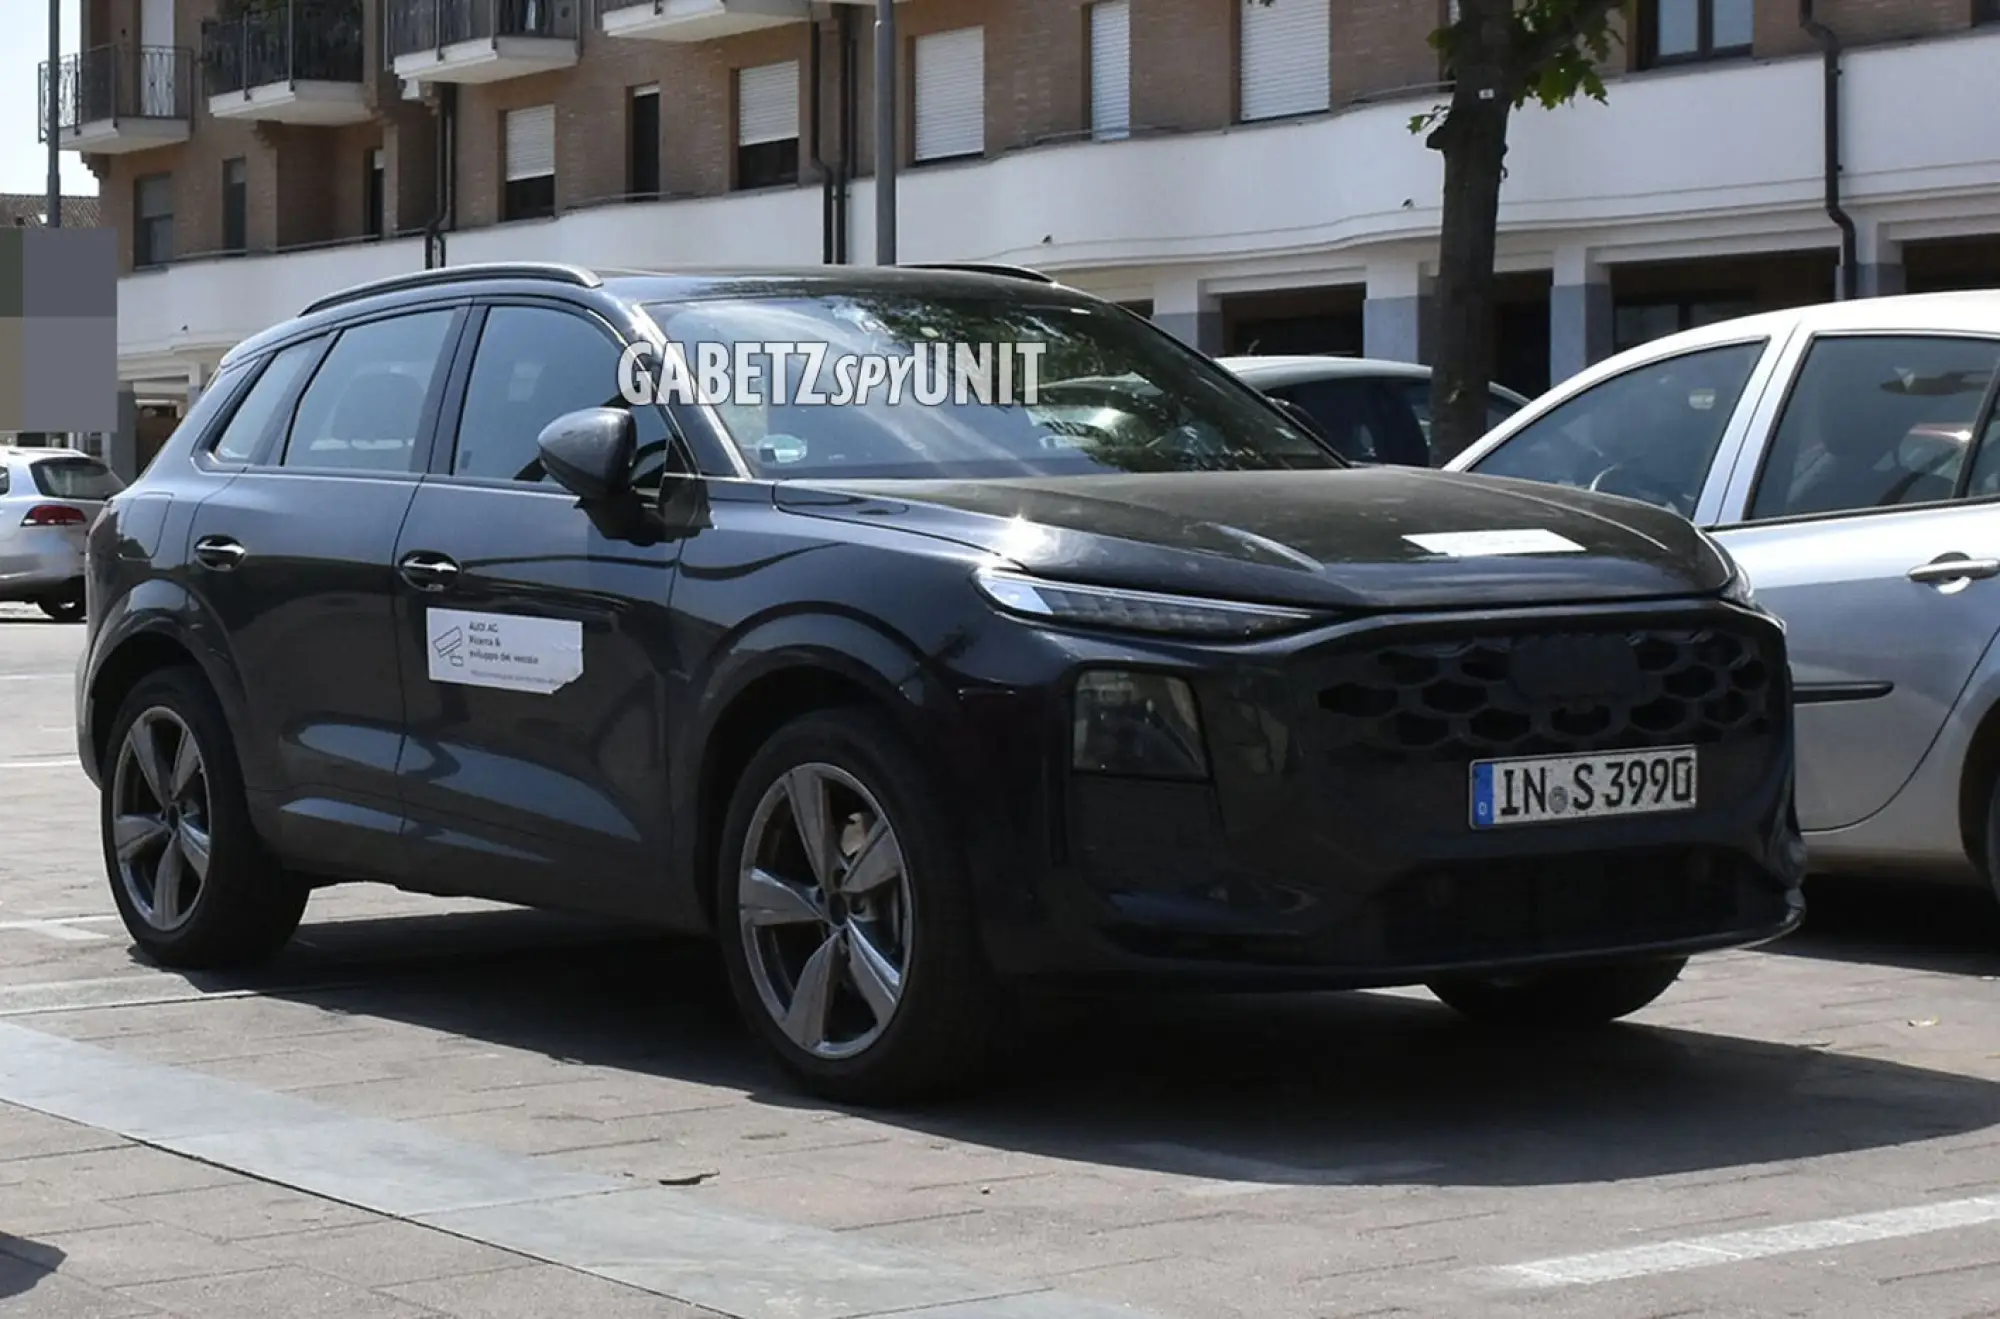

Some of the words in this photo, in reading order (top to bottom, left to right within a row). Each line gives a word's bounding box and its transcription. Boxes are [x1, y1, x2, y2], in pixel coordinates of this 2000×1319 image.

[1501, 766, 1547, 816] IN
[1573, 763, 1595, 811] S
[1604, 756, 1692, 808] 3990
